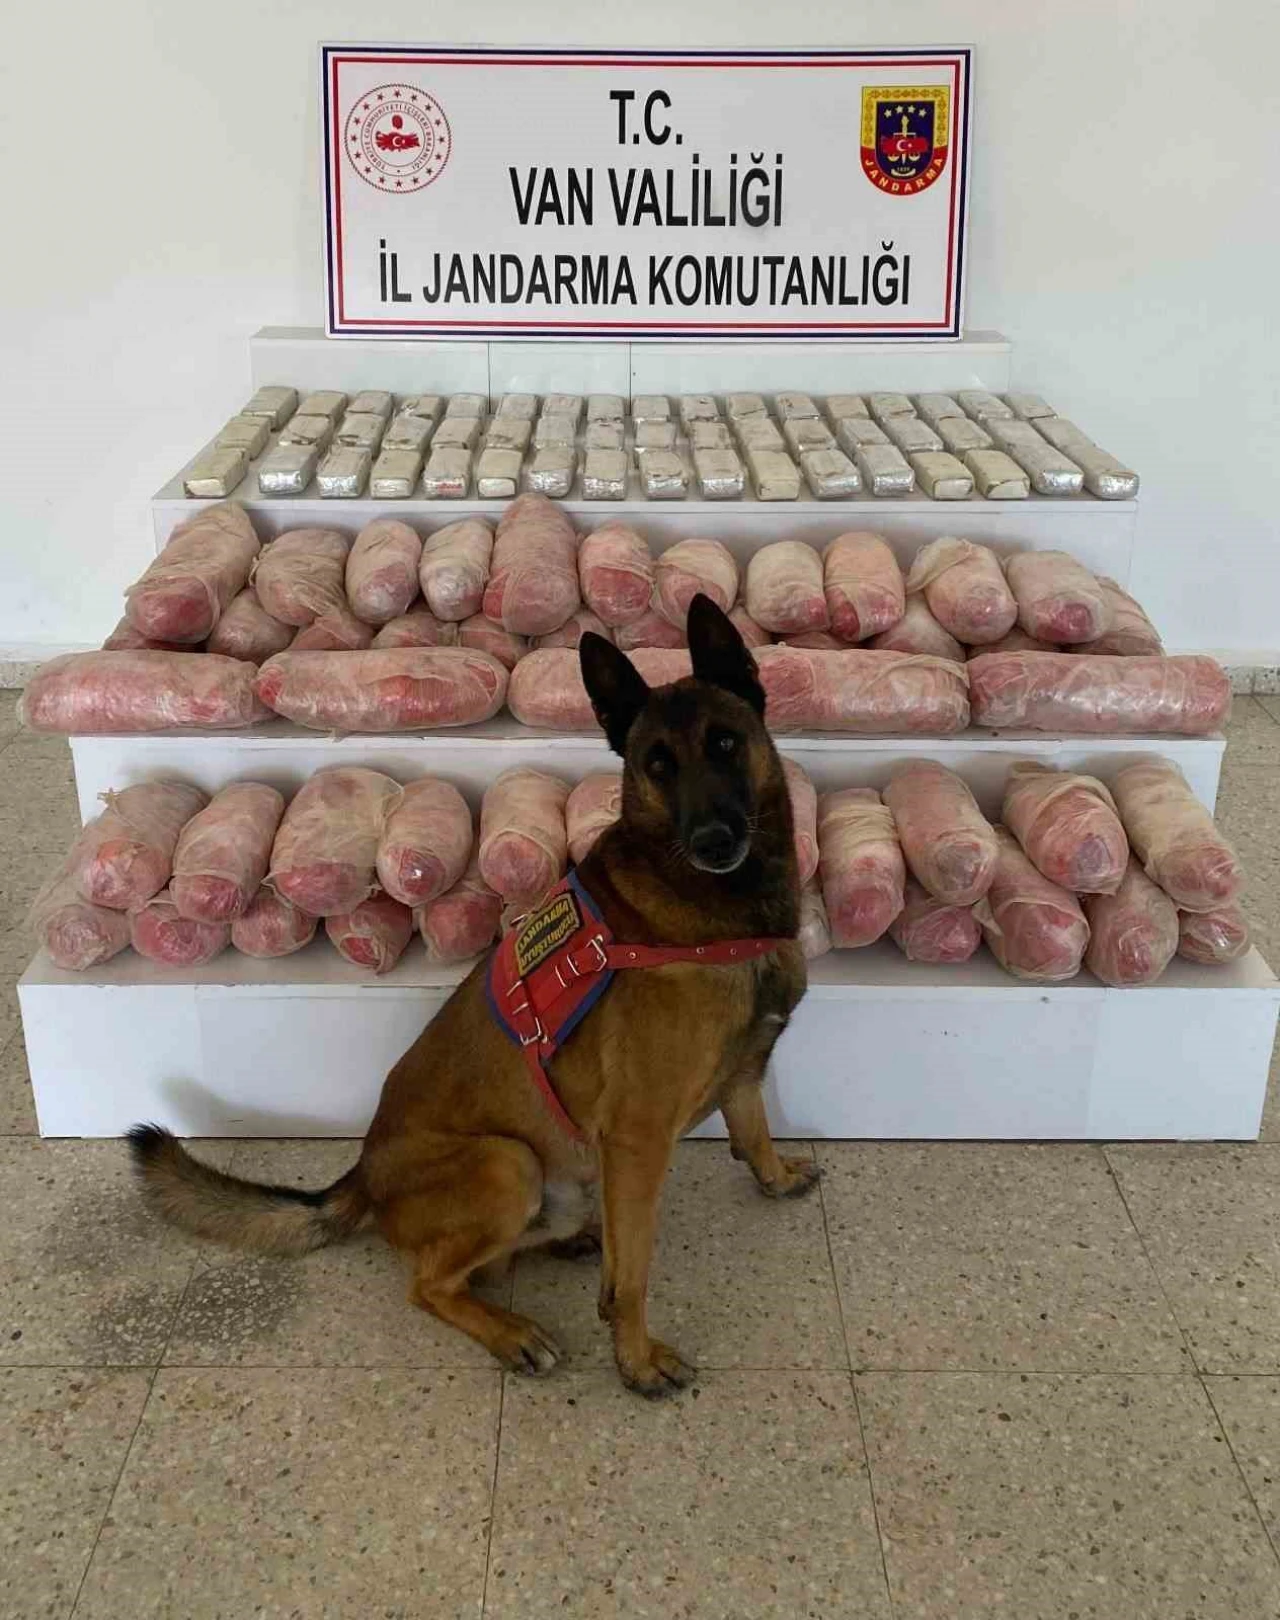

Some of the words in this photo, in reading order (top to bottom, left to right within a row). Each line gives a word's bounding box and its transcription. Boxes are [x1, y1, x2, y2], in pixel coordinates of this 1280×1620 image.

[610, 90, 683, 146] T.C.
[509, 167, 592, 226] VAN
[608, 153, 783, 228] VALİLİĞİ
[865, 158, 943, 191] JANDARMA
[380, 239, 411, 303] İL
[423, 254, 638, 305] JANDARMA
[649, 241, 910, 307] KOMUTANLIĞI
[518, 899, 569, 954] JANDARMA
